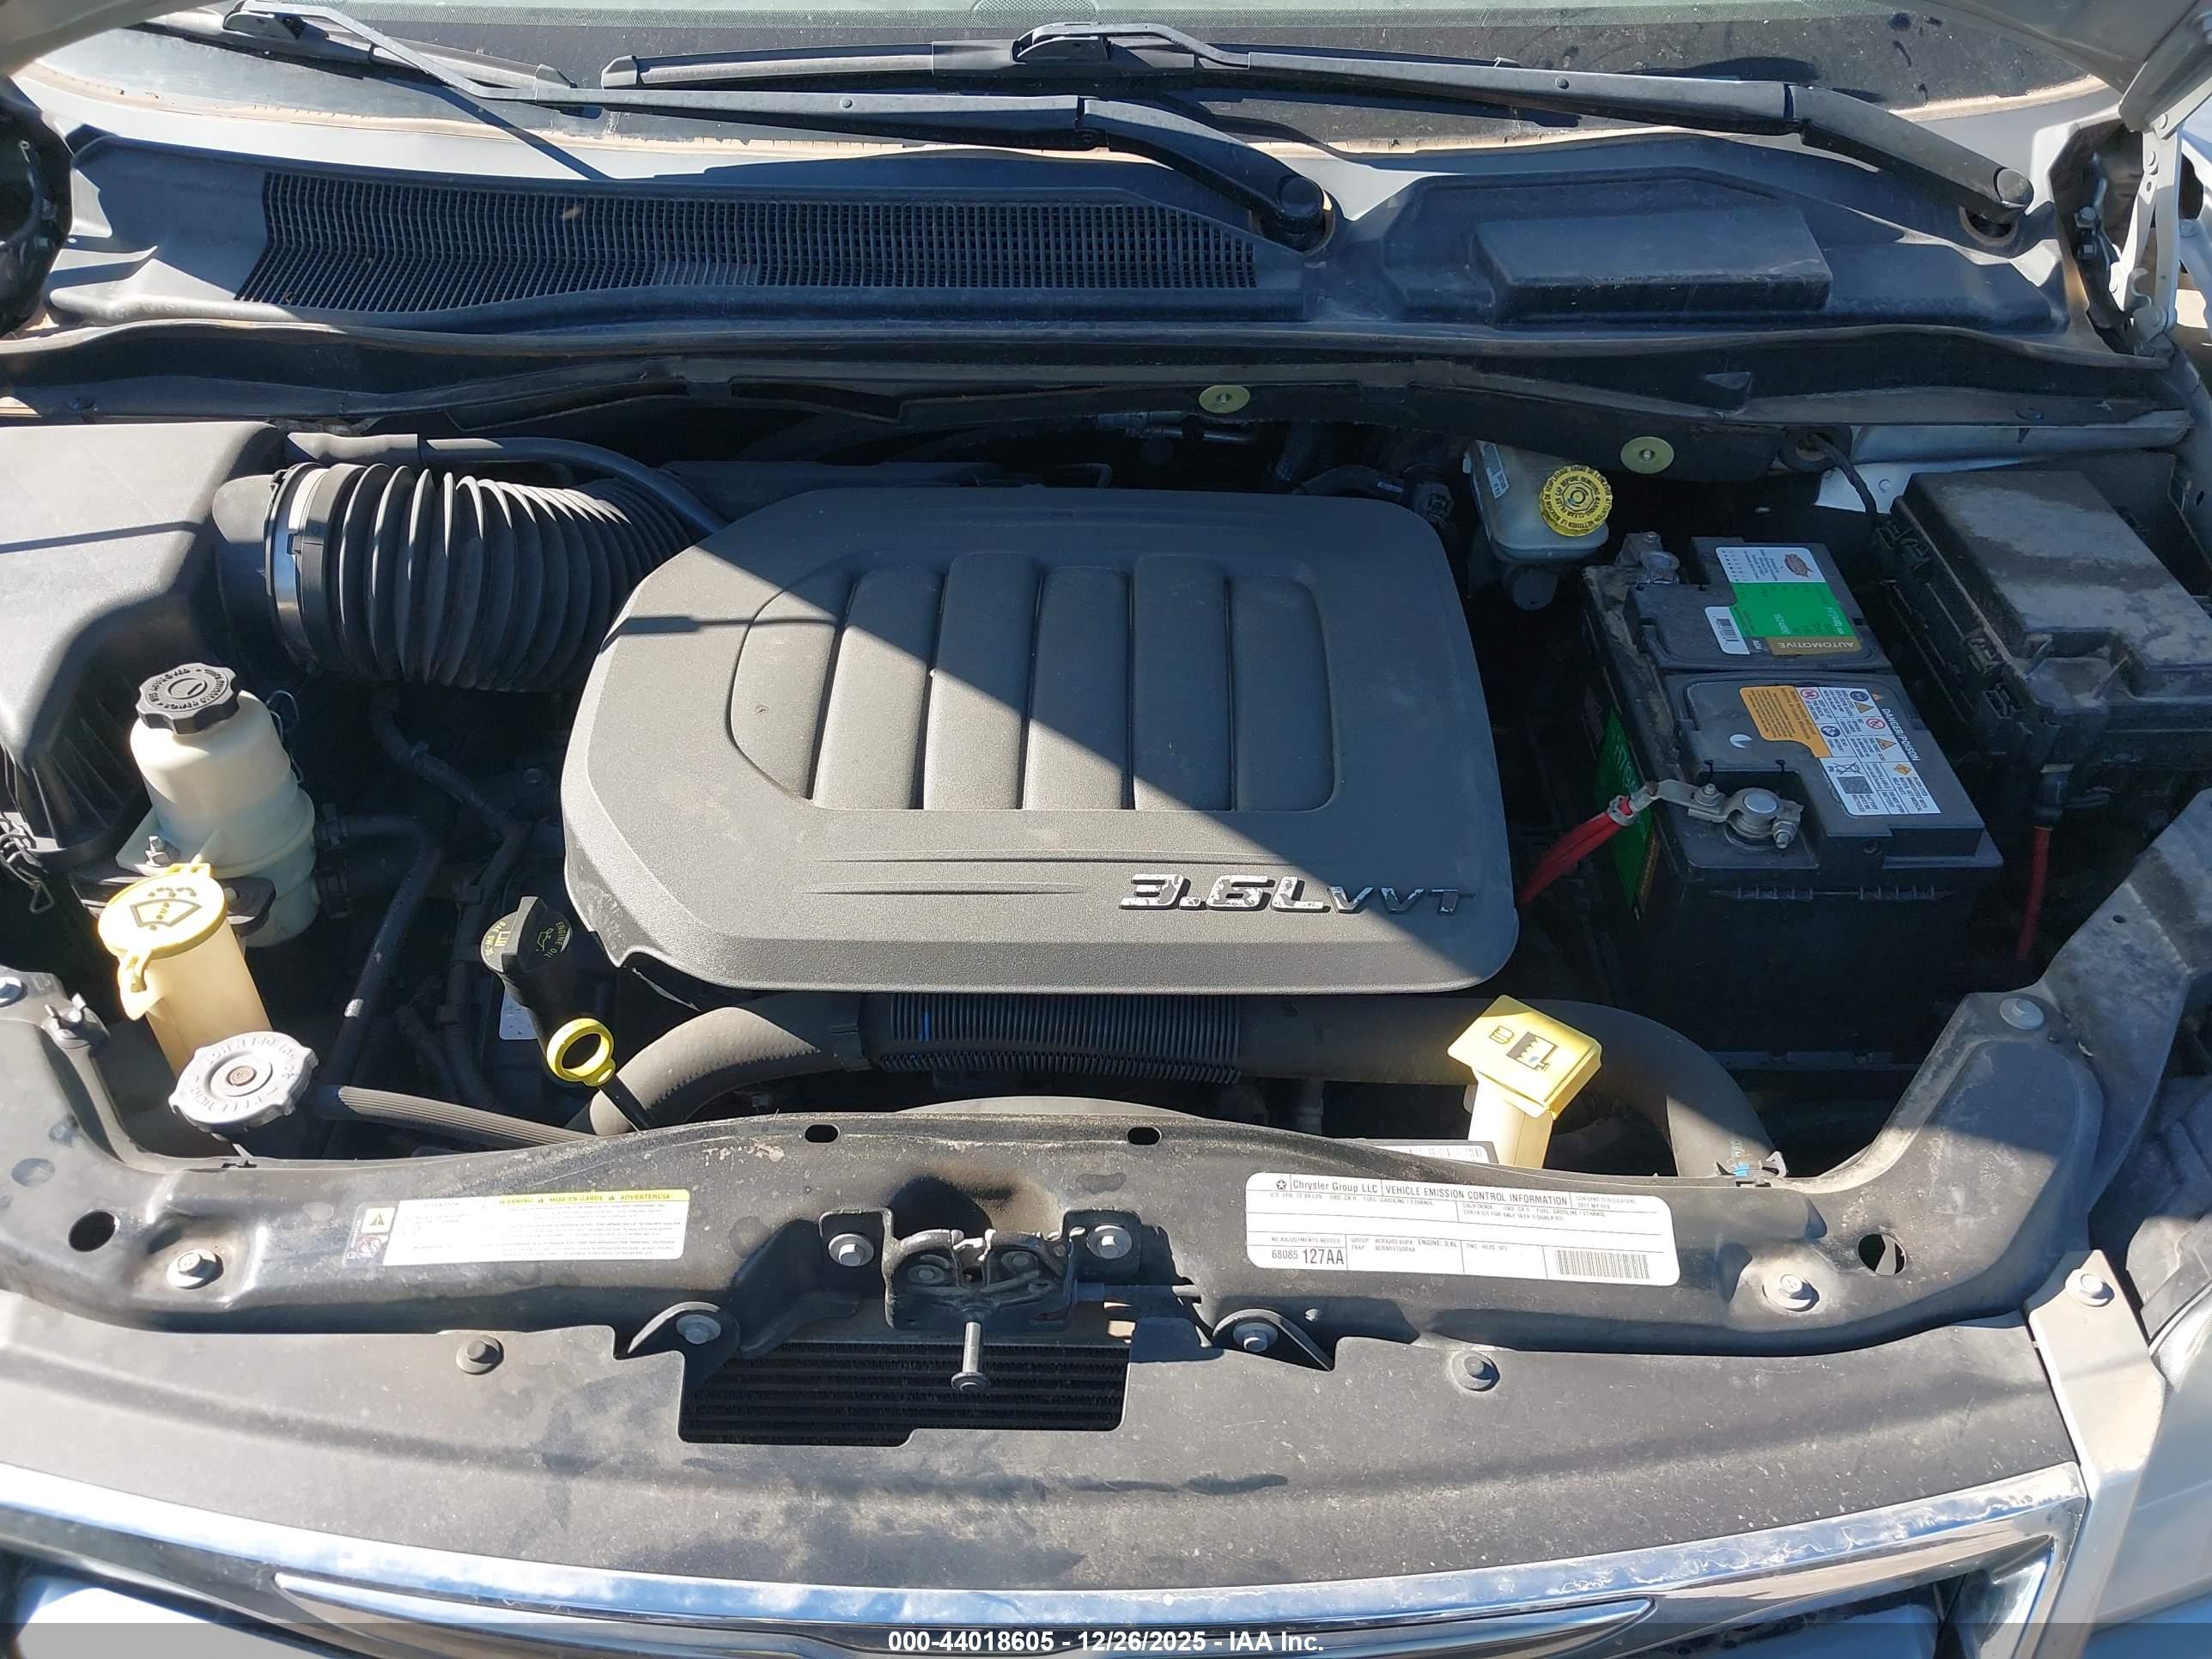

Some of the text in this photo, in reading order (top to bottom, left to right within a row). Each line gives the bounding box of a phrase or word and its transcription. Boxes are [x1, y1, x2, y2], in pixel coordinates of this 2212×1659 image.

[1778, 639, 1854, 650] AUTOMOTIVE
[1882, 708, 1921, 763] DANGER/POISON
[1119, 873, 1475, 915] 3.6L VVT
[544, 921, 567, 958] ENGINE OIL
[1293, 1180, 1378, 1193] Chrysler Group LLC
[1386, 1186, 1567, 1206] VEHICLE EMISSION CONTROL INFORMATION
[1272, 1249, 1344, 1265] 68085 127AA
